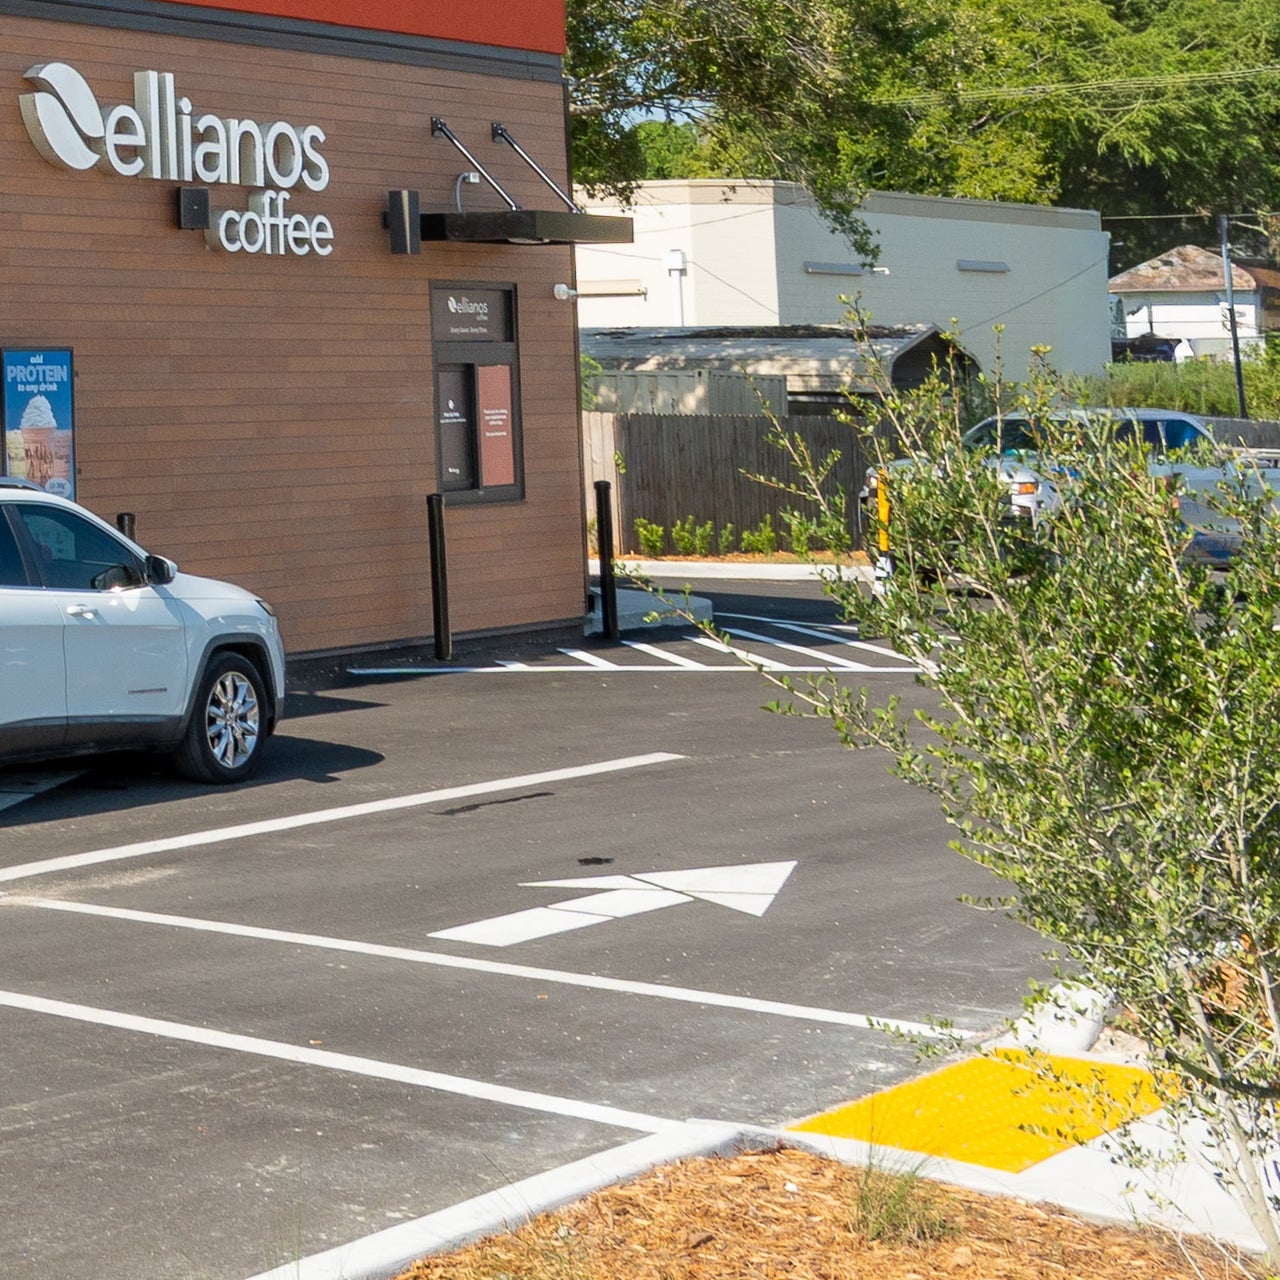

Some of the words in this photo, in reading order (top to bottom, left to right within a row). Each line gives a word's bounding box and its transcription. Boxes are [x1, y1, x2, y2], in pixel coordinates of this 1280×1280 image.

[104, 69, 330, 192] ellianos
[218, 189, 335, 256] coffee
[457, 296, 489, 313] ellianos
[30, 354, 44, 364] add
[6, 365, 68, 383] PROTEIN
[17, 384, 25, 392] to
[25, 385, 39, 394] any
[39, 383, 58, 392] drink
